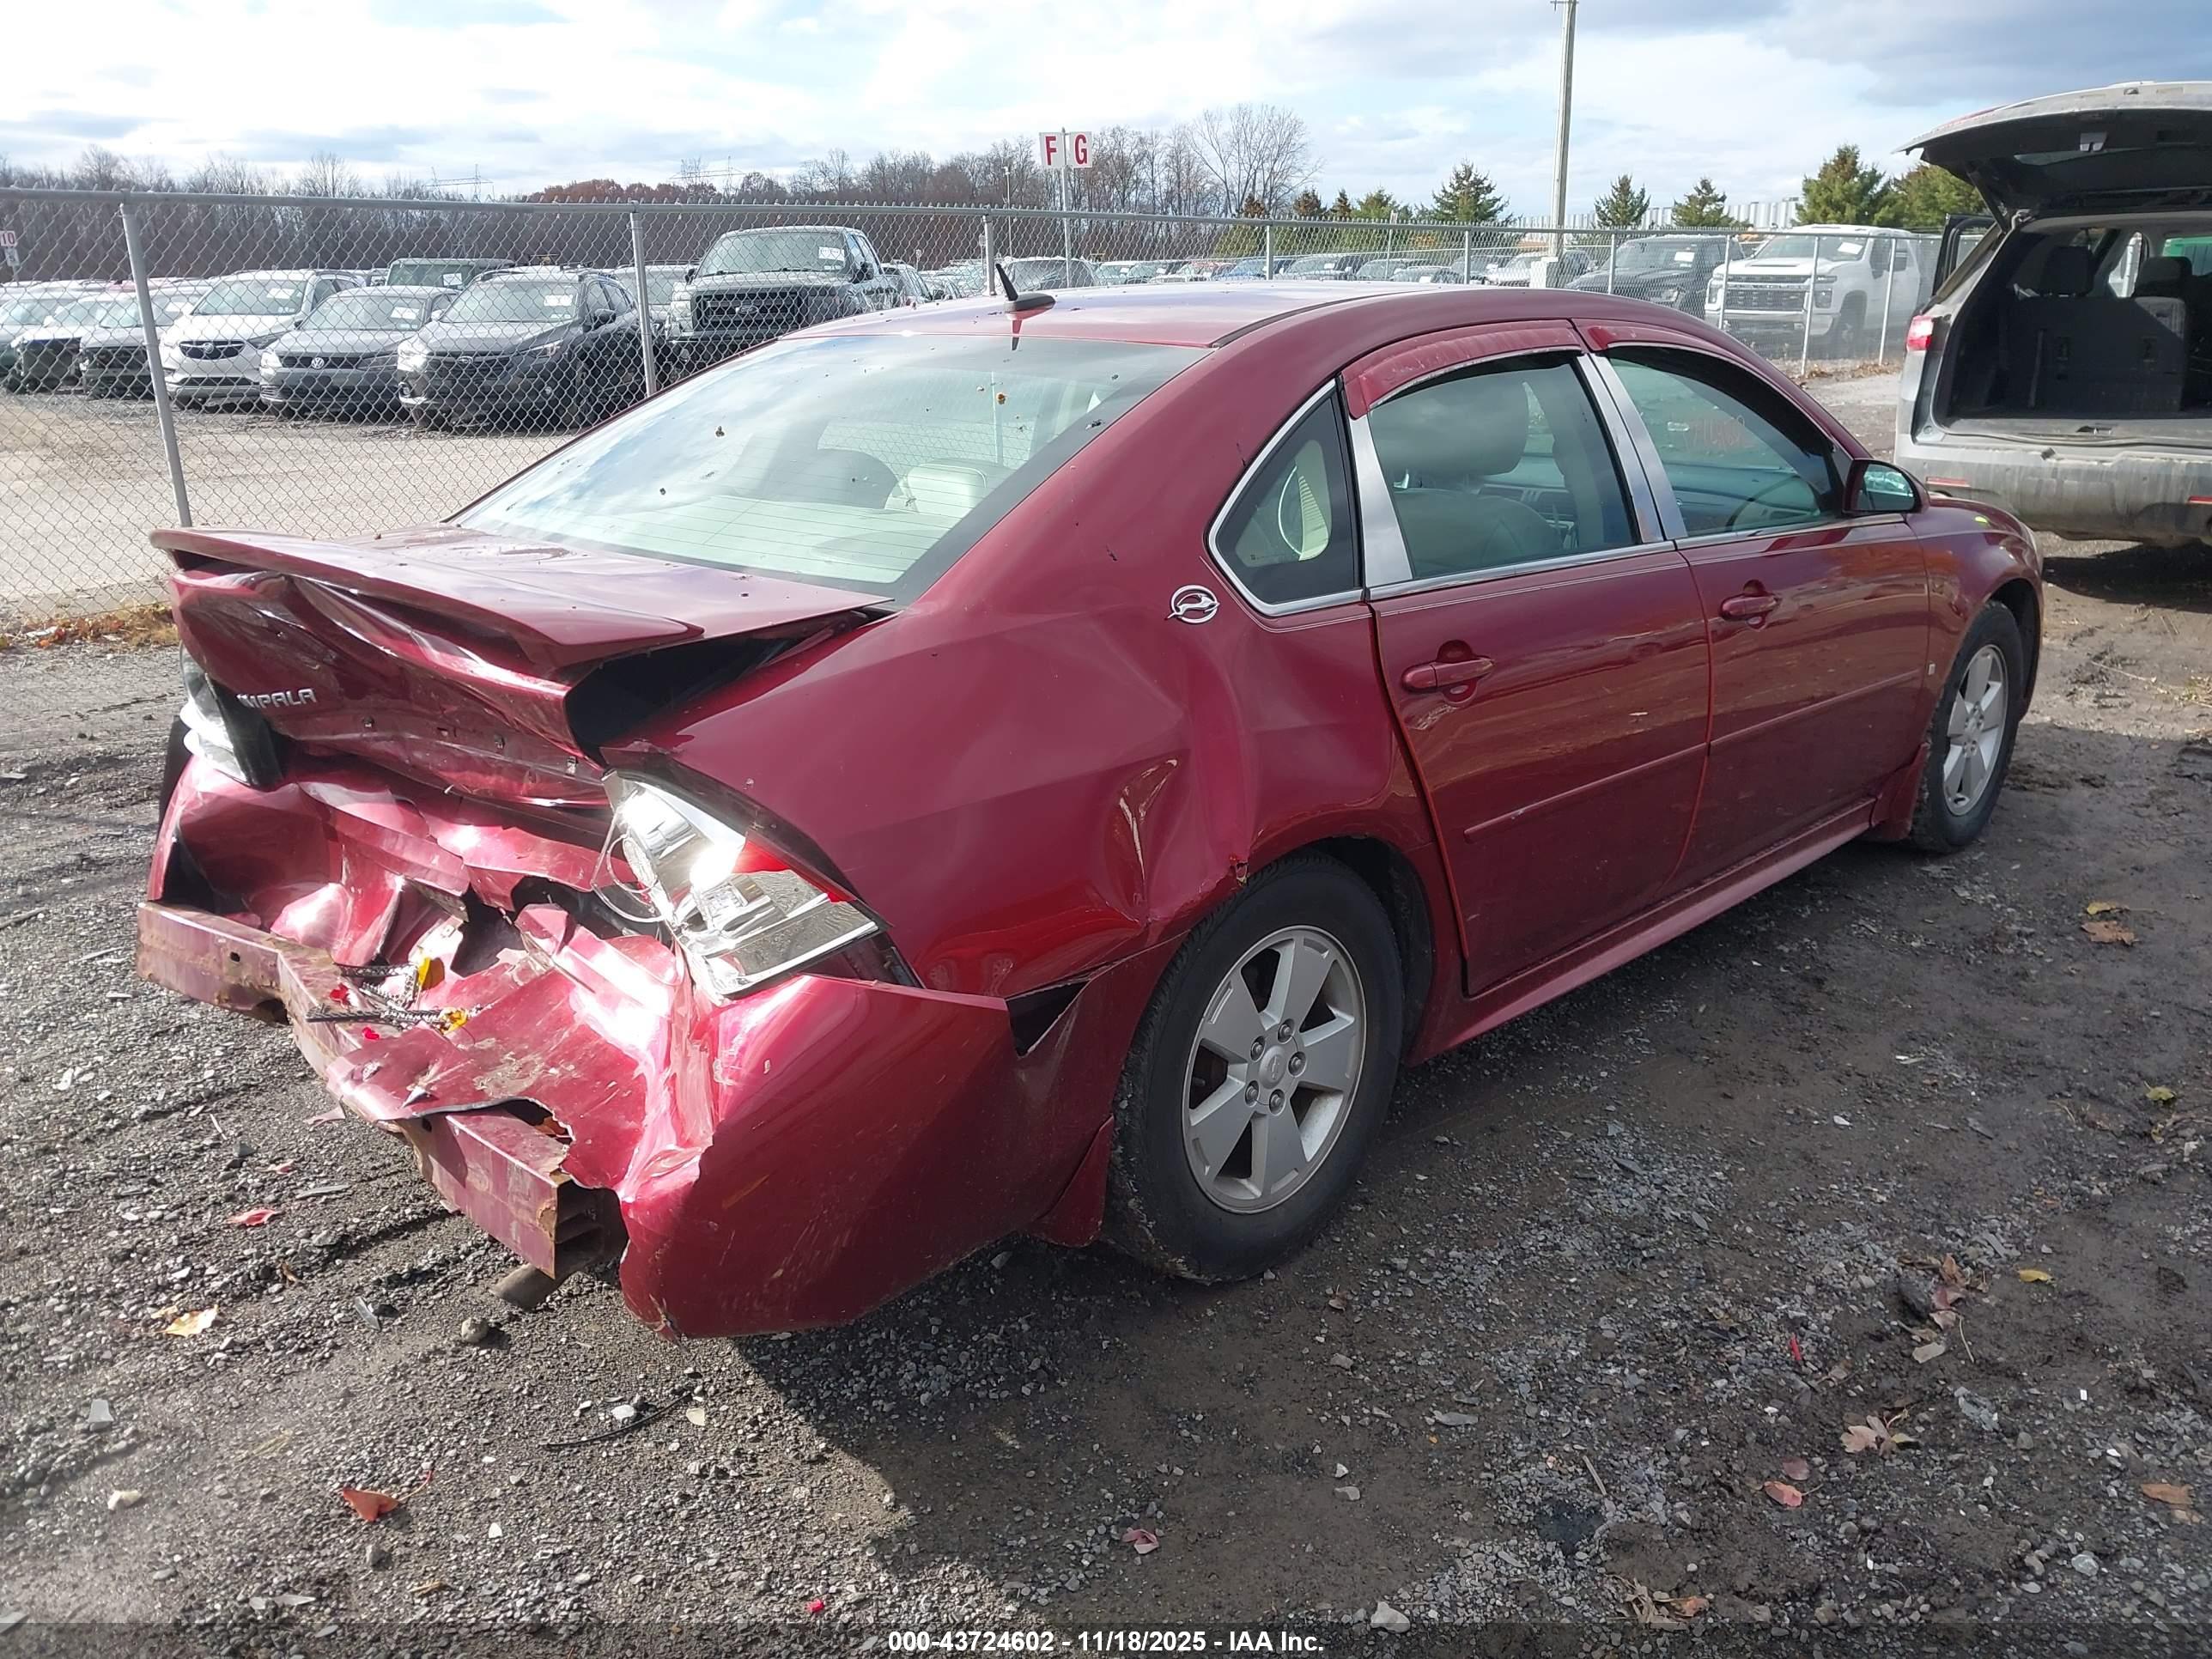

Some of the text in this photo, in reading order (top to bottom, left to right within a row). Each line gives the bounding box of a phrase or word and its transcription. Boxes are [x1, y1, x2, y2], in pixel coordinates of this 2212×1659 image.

[1045, 136, 1057, 166] F
[1074, 134, 1088, 165] G
[2, 232, 15, 246] 10
